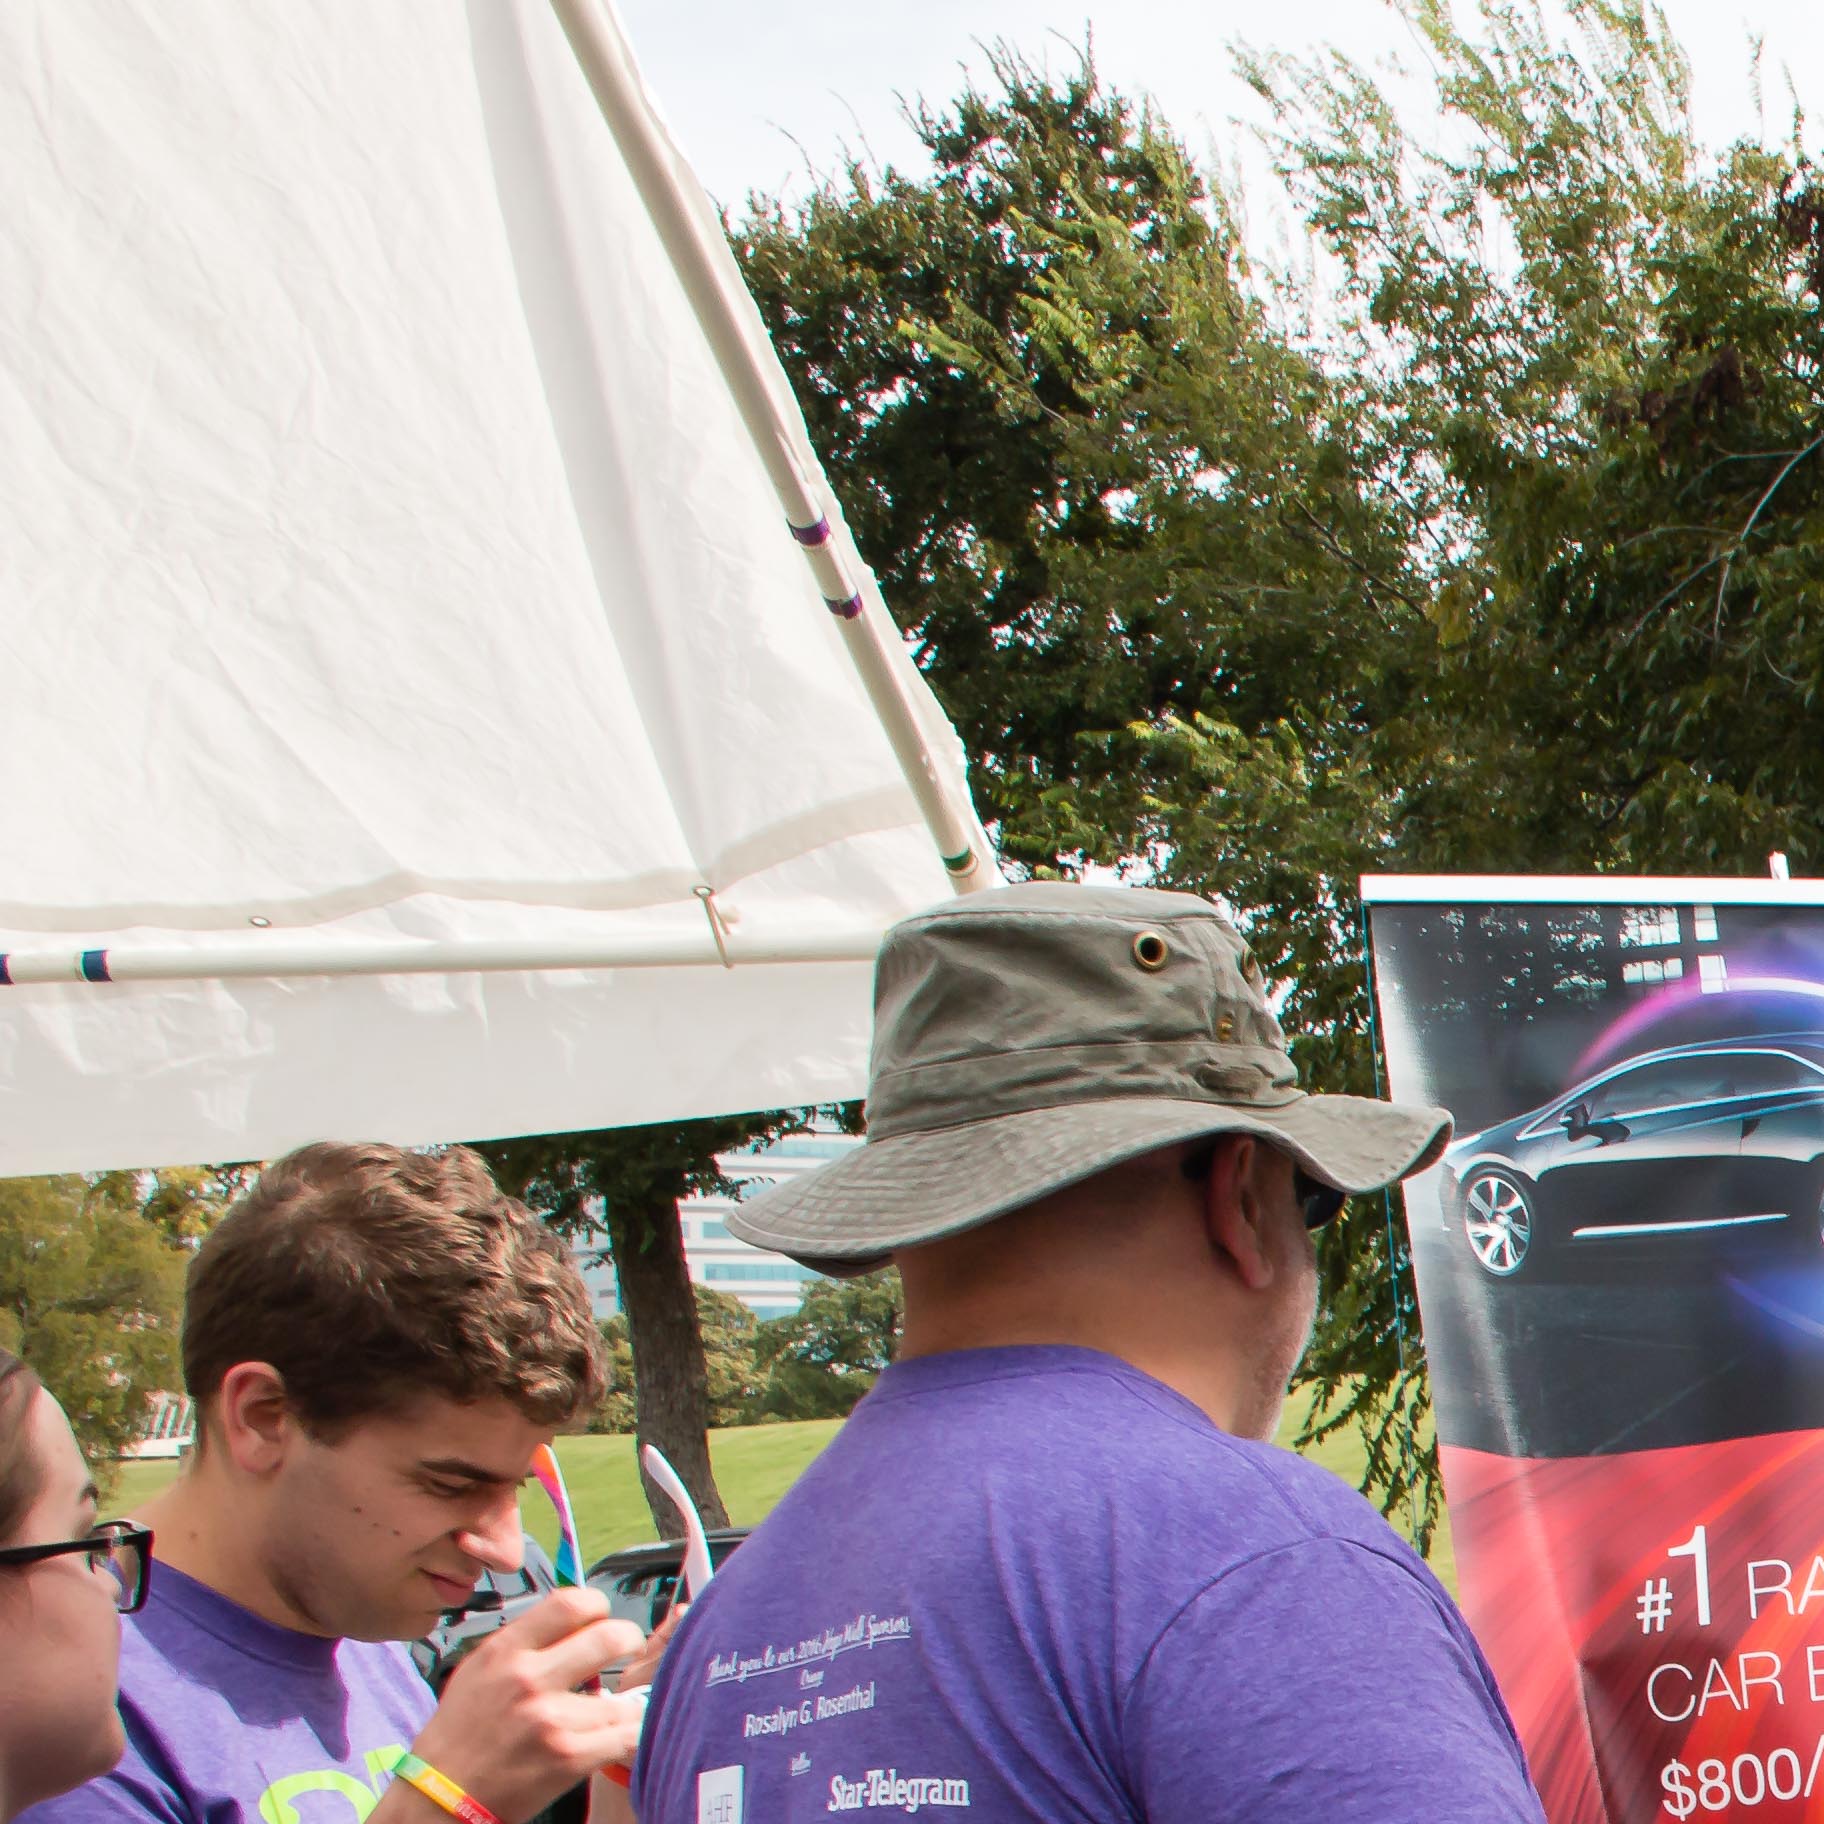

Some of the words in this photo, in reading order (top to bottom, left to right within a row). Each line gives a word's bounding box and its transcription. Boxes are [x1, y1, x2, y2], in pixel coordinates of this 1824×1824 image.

[1636, 1524, 1711, 1634] #1
[743, 1705, 799, 1738] Rosalyn
[815, 1680, 876, 1721] Rosenthal
[1646, 1647, 1785, 1723] CAR
[826, 1767, 971, 1814] Star-Telegram
